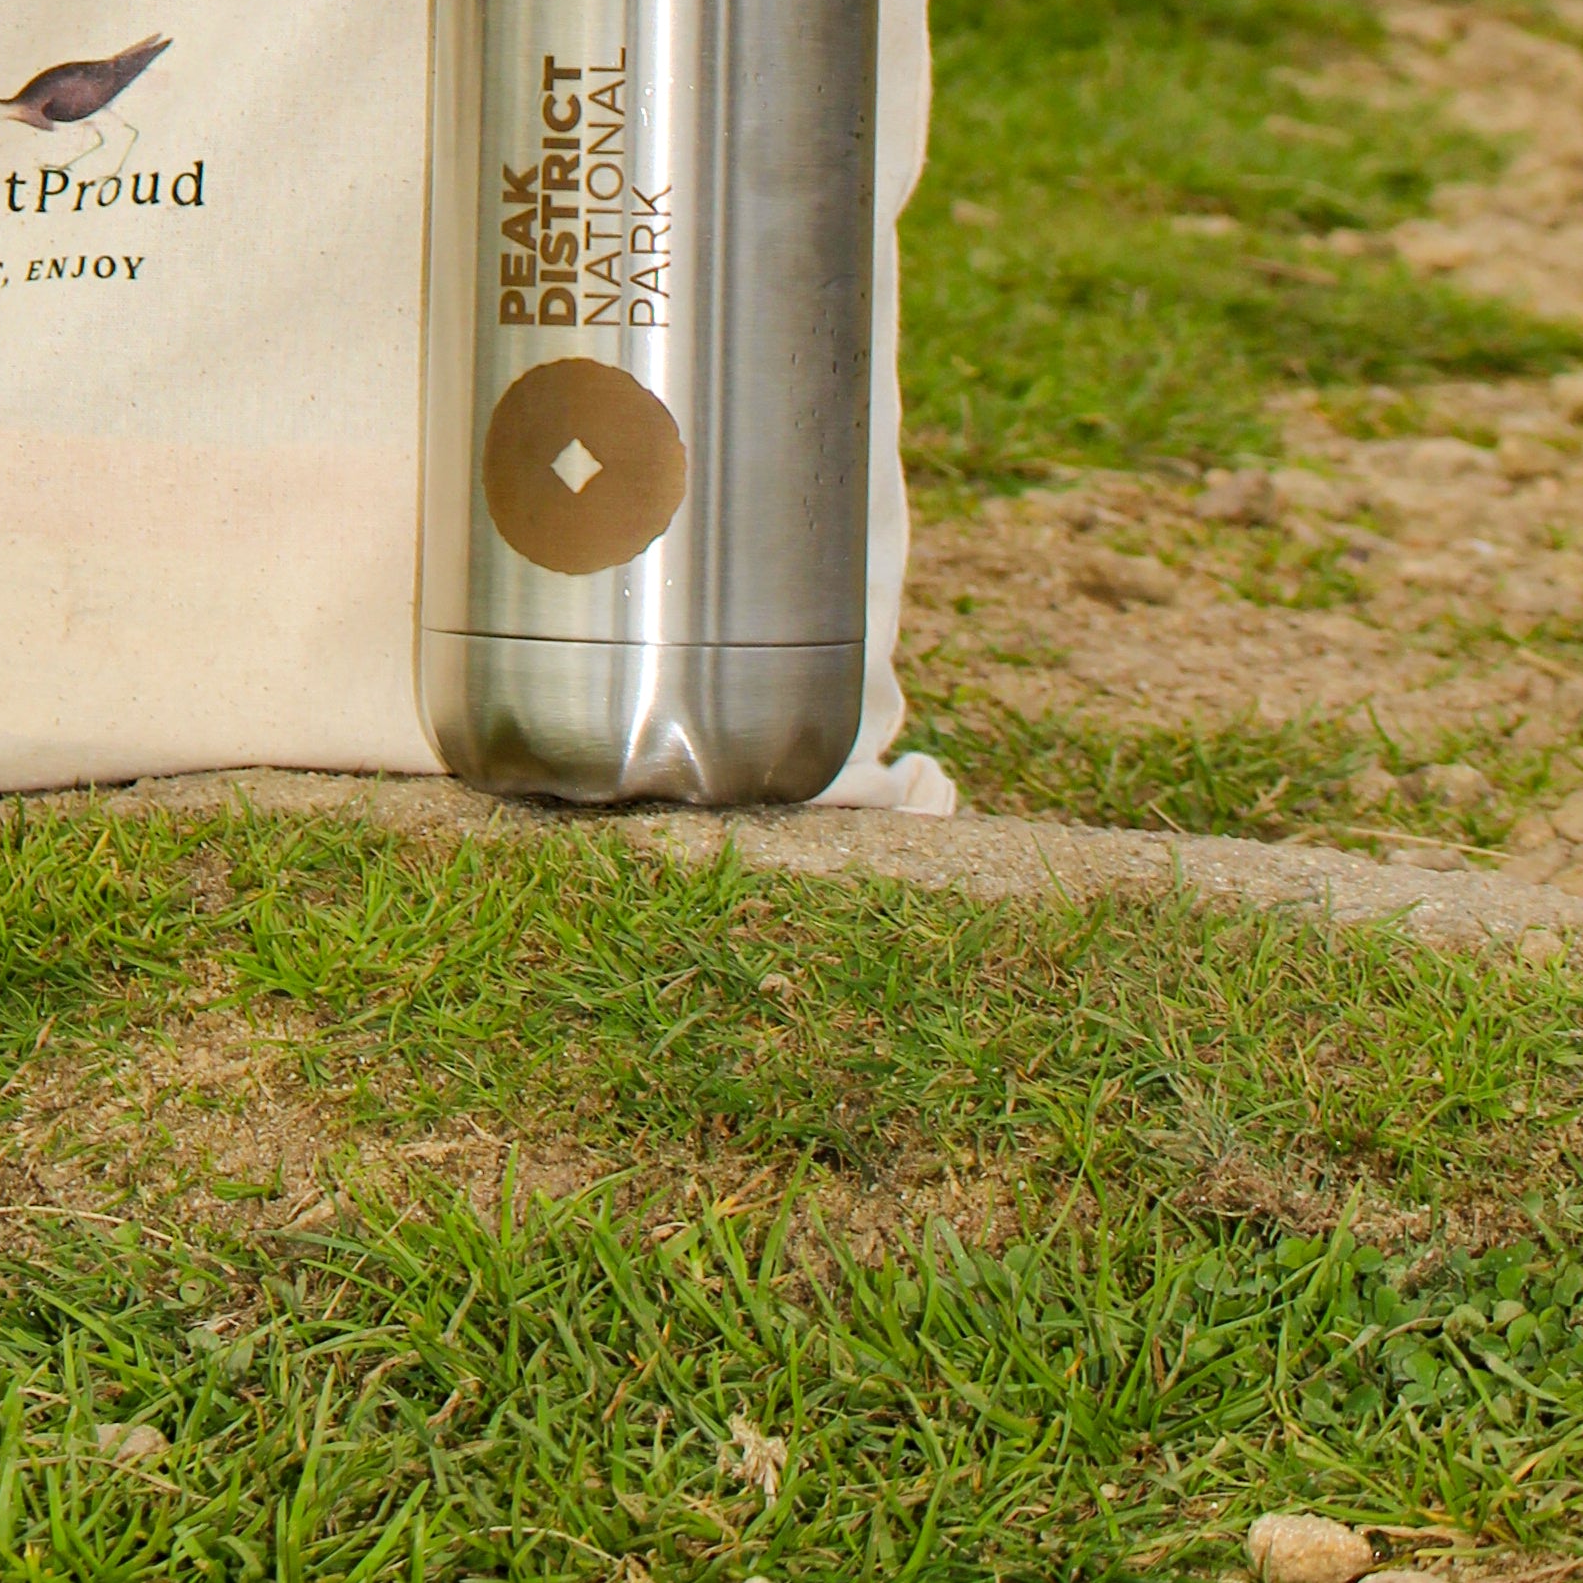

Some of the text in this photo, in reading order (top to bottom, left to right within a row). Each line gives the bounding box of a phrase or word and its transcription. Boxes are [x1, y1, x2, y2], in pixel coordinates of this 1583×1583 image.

[501, 165, 538, 325] PEAK
[539, 55, 582, 326] DISTRICT
[584, 47, 626, 325] NATIONAL
[629, 185, 671, 327] PARK
[25, 254, 145, 283] ENJOY
